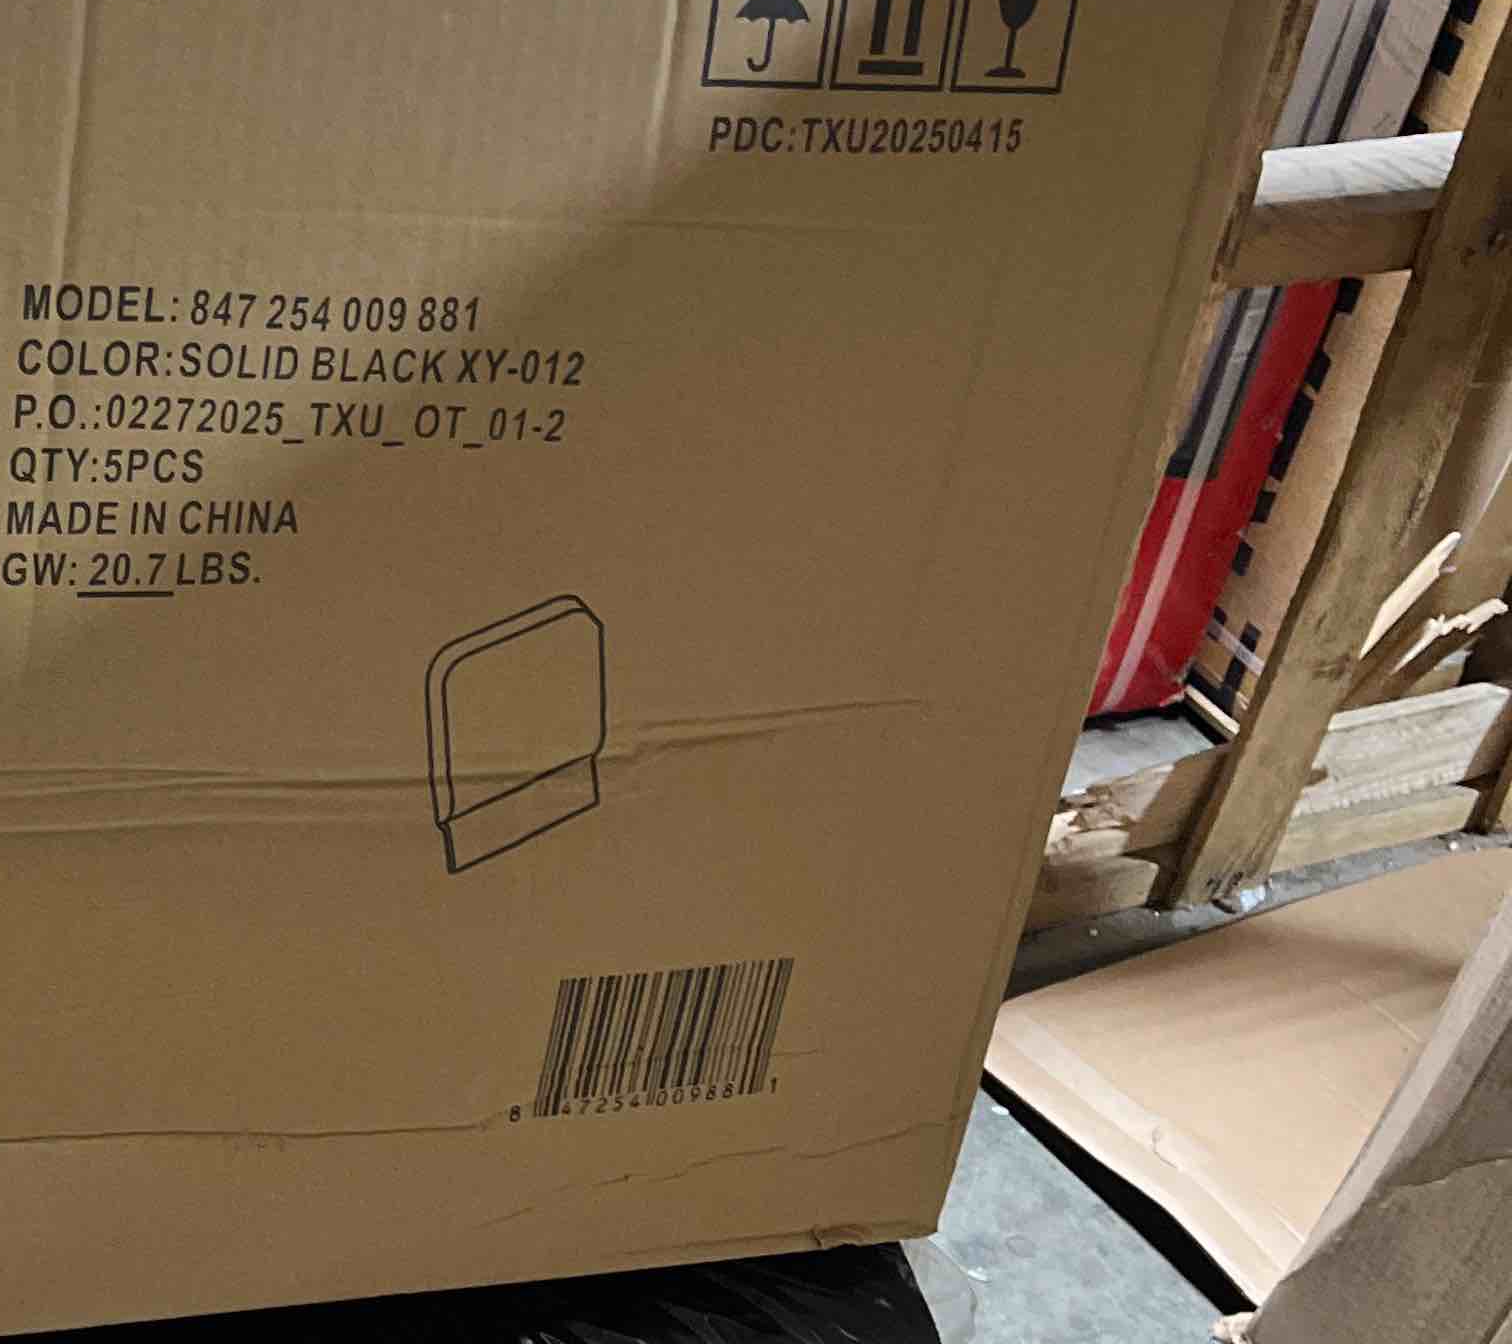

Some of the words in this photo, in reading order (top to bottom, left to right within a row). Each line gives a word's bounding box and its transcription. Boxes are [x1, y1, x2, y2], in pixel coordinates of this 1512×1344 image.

[707, 116, 1024, 154] PDC:TXU20250415
[23, 283, 179, 323] MODEL:
[190, 289, 257, 328] 847
[265, 294, 331, 333] 254
[343, 296, 408, 333] 009
[417, 296, 480, 333] 881
[311, 346, 447, 384] BLACK
[456, 348, 585, 386] XY-012
[9, 446, 205, 483] QTY:5PCS
[6, 500, 119, 536] MADE
[129, 501, 167, 536] IN
[178, 500, 299, 536] CHINA
[1, 551, 78, 587] GW:
[88, 552, 167, 587] 20.7
[176, 550, 262, 586] LBS.
